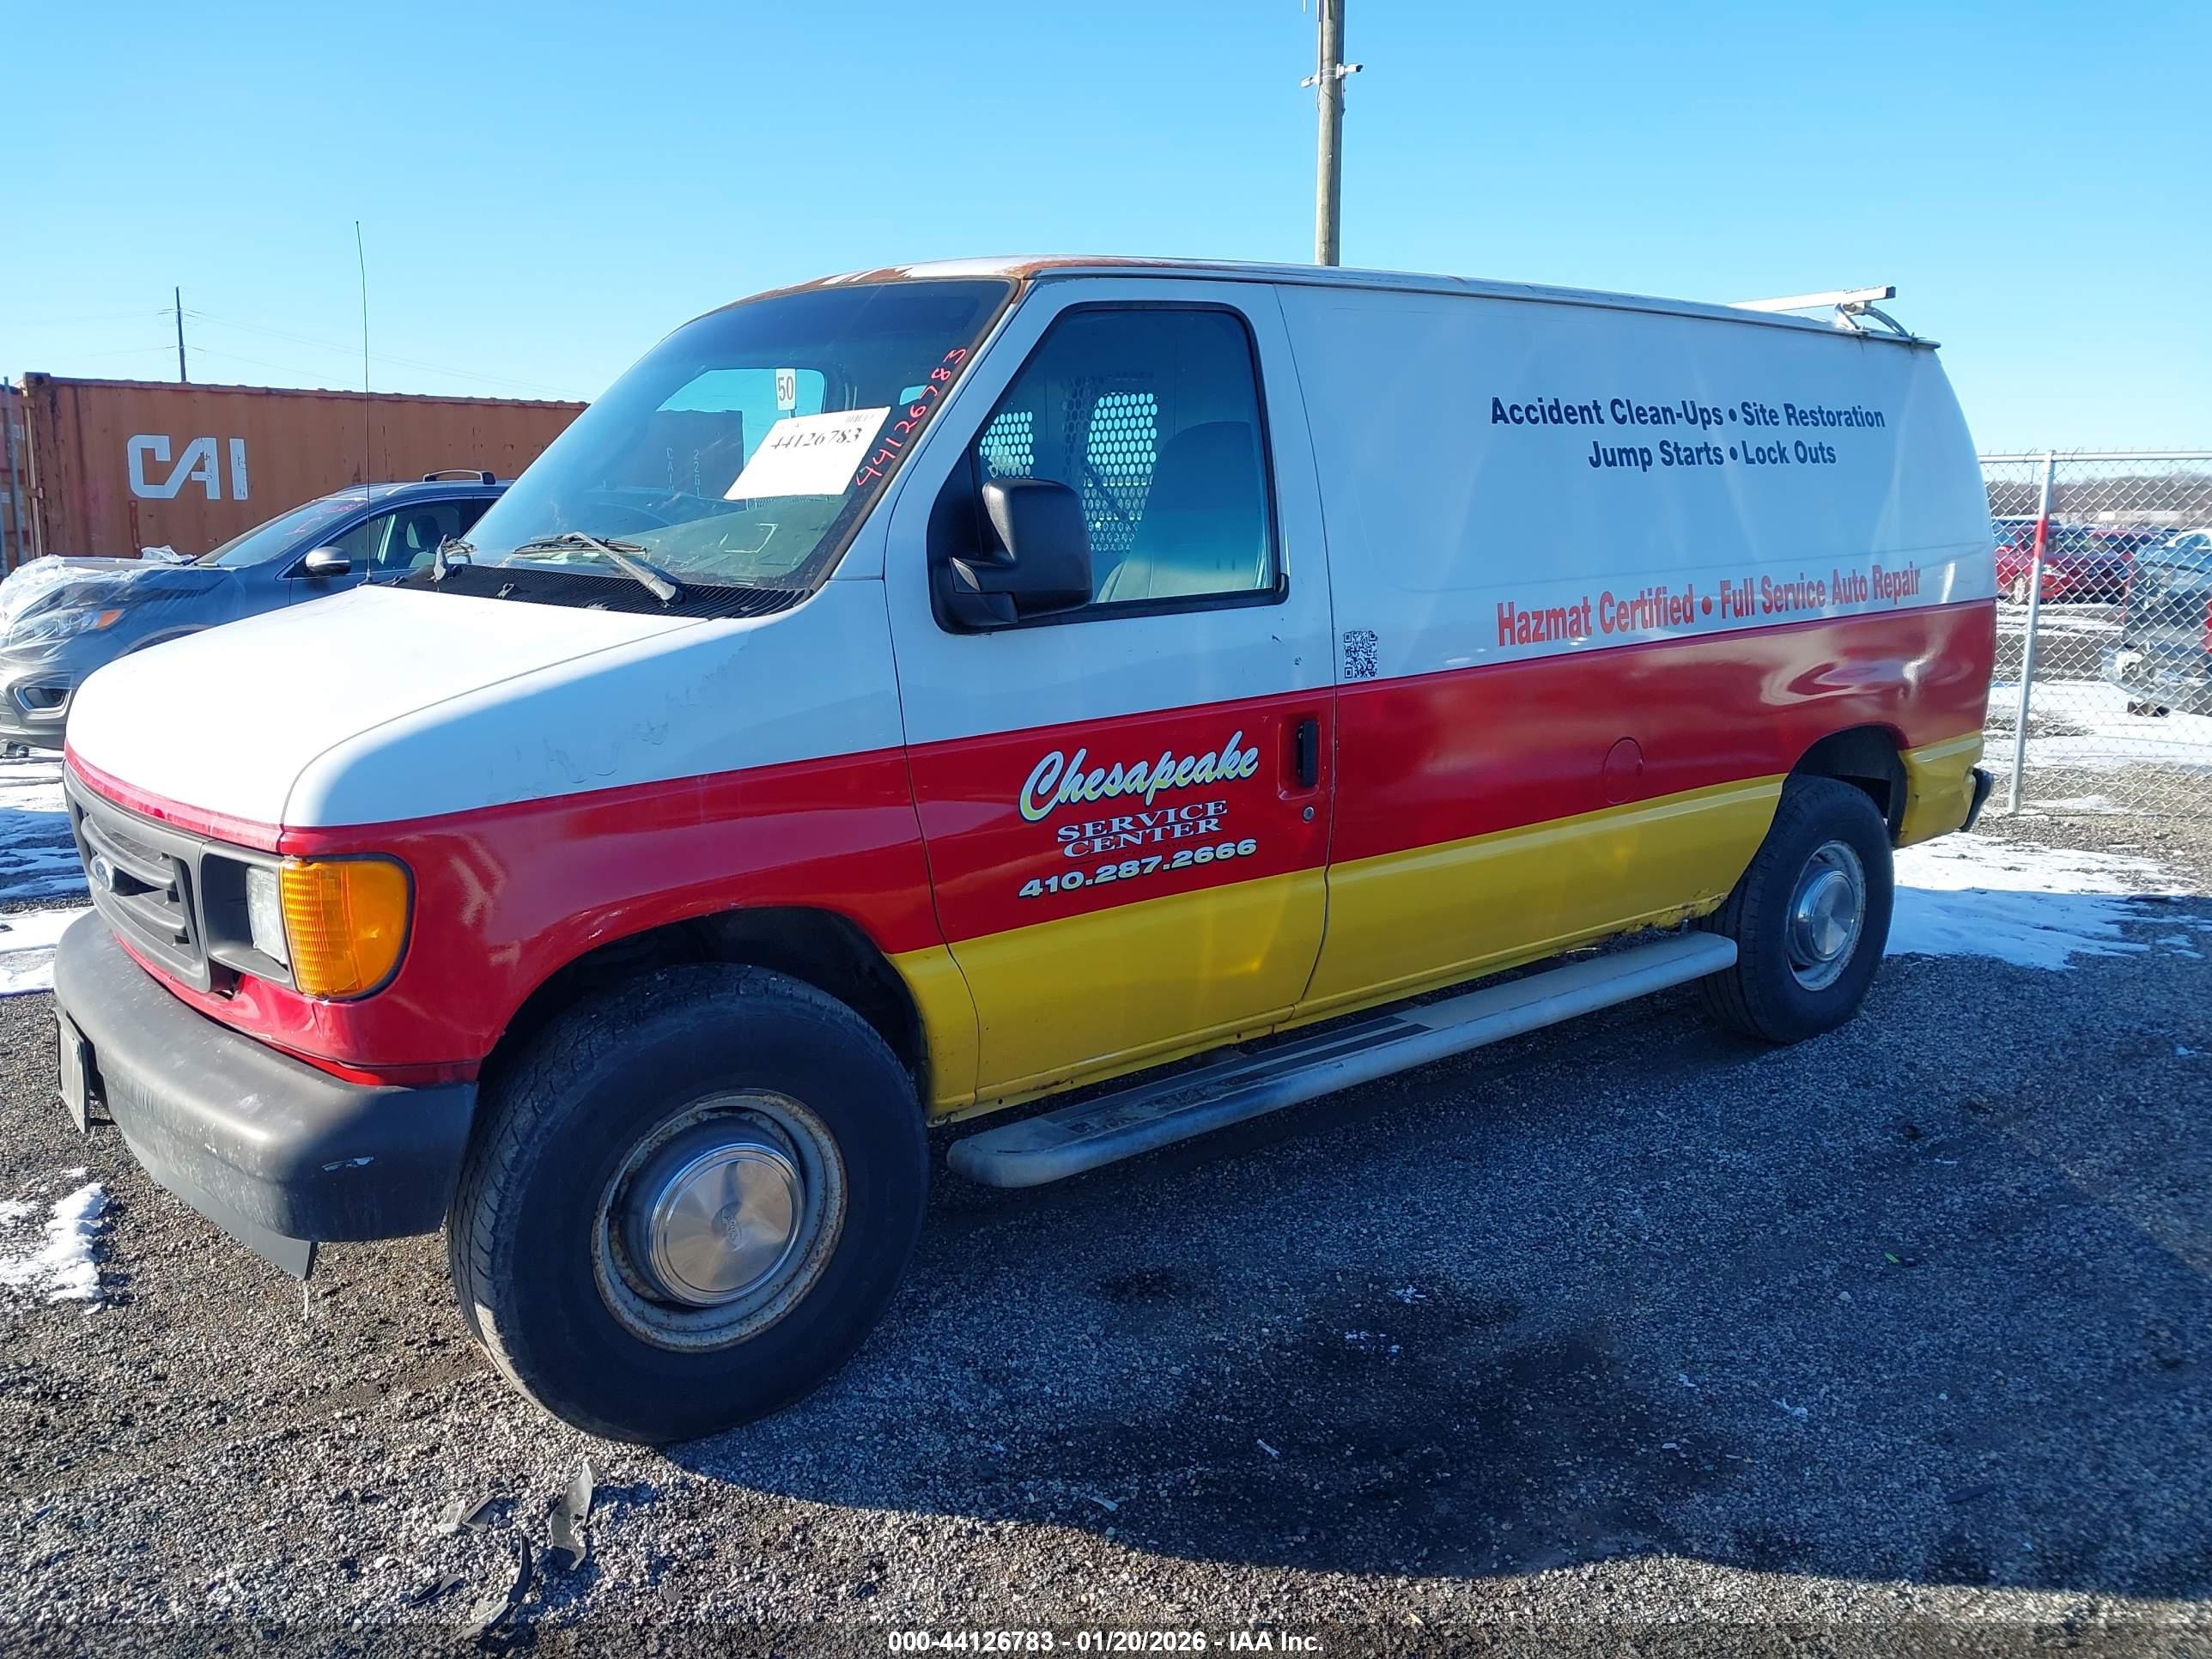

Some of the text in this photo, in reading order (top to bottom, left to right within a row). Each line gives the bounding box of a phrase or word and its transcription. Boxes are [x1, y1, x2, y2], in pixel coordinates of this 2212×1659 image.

[777, 375, 794, 402] 50
[856, 348, 967, 486] 44126783
[1492, 397, 1886, 430] Accident Clean-Ups Site Restoration
[771, 427, 863, 450] 44126783
[1589, 440, 1837, 472] Jump Starts Lock Outs
[127, 434, 248, 501] CAI
[1497, 561, 1921, 647] Hazmat Certified Full Service Auto Repair
[1019, 730, 1260, 822] Chesapeake
[1057, 799, 1228, 843] SERVICE
[1063, 817, 1224, 858] CENTER
[1018, 838, 1258, 897] 410.287.2666
